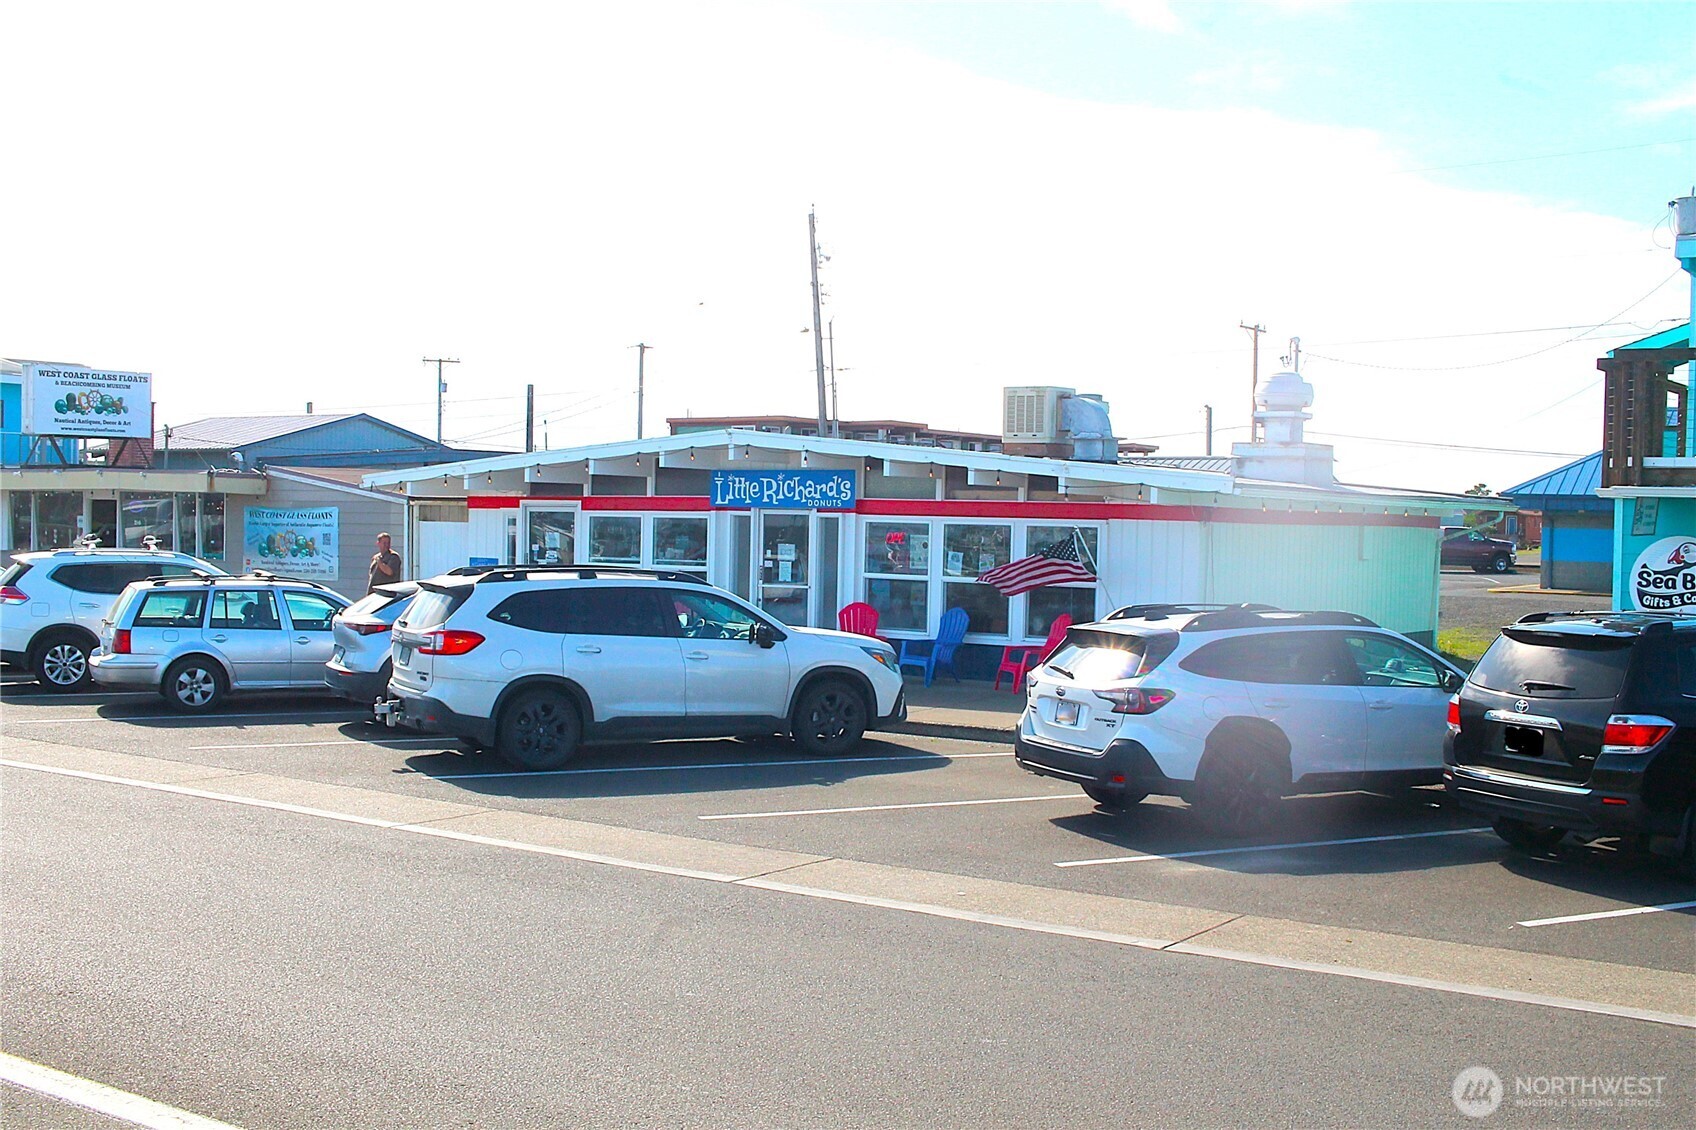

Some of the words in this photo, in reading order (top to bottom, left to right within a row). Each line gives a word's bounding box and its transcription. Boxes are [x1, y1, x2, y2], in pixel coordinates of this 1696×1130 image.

[38, 370, 62, 379] WEST
[63, 371, 90, 380] COAST
[91, 373, 117, 382] GLASS
[118, 375, 148, 383] FLOATS
[714, 472, 760, 505] Little
[760, 472, 851, 505] Richard's
[807, 499, 842, 507] DONUTS
[249, 511, 266, 519] WEST
[266, 511, 287, 519] COAST
[287, 511, 308, 519] GLASS
[308, 511, 333, 520] FLOATS
[1637, 570, 1677, 590] Sea
[1642, 595, 1670, 607] Gifts
[1671, 595, 1681, 606] &
